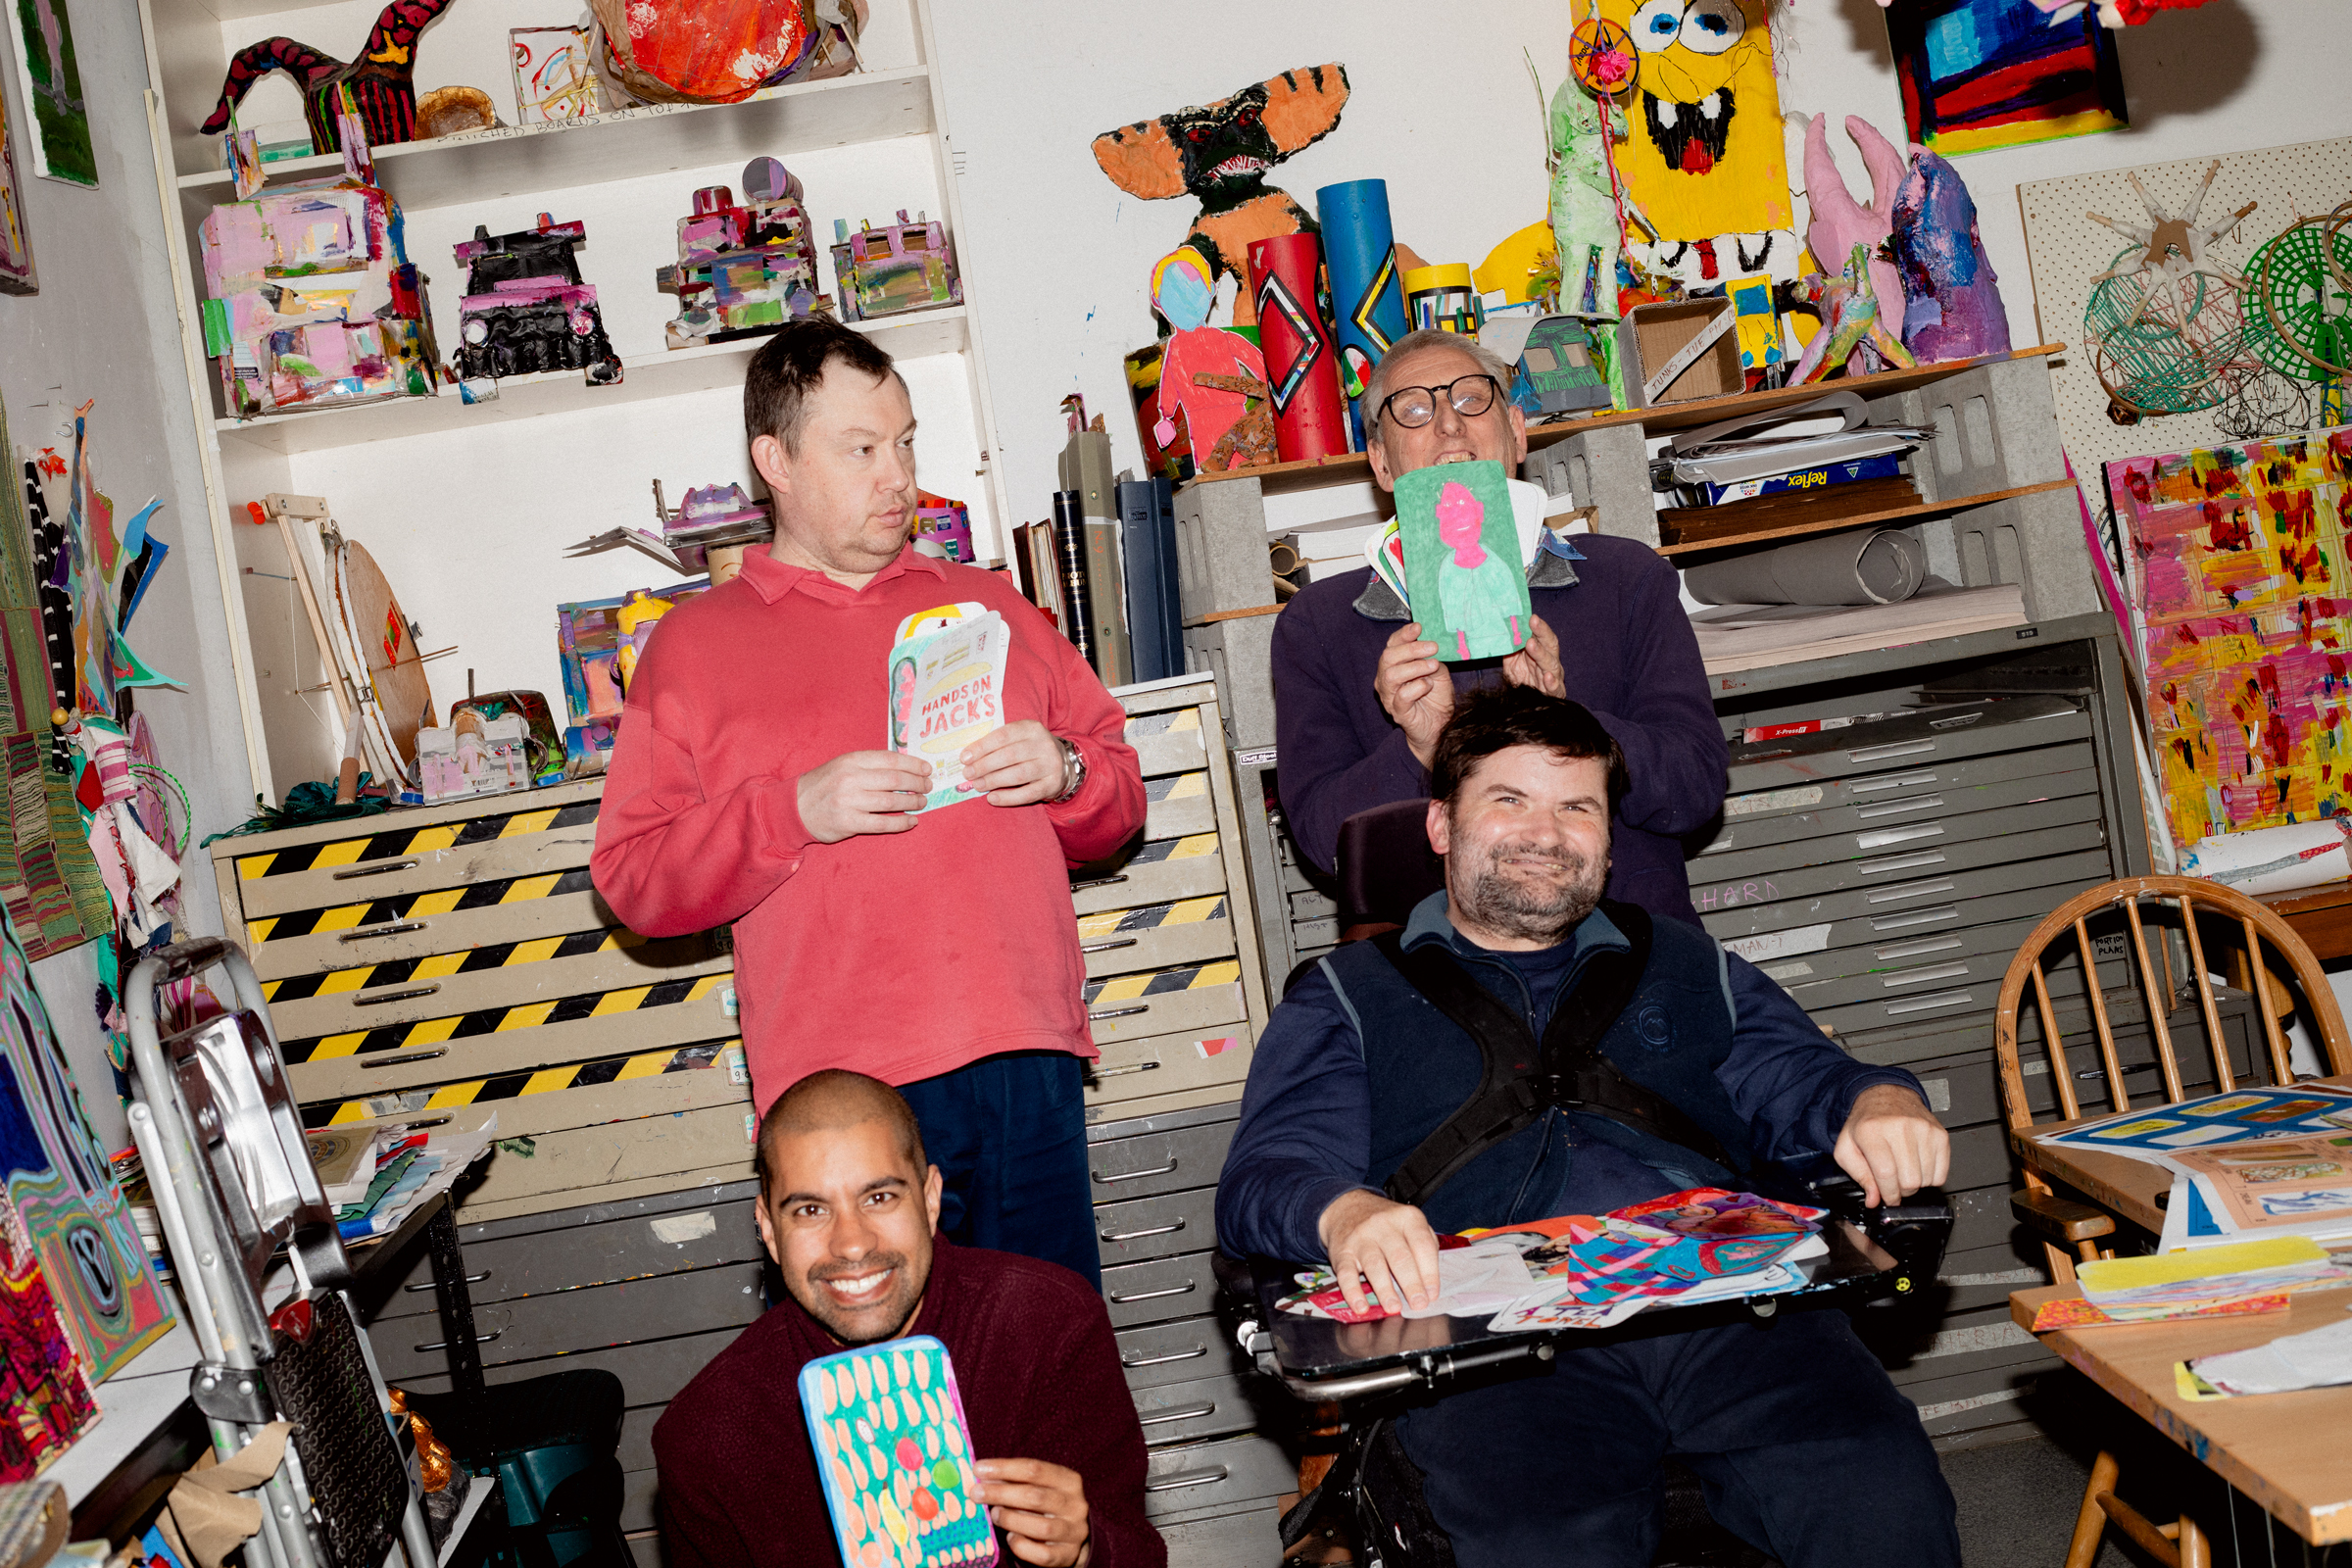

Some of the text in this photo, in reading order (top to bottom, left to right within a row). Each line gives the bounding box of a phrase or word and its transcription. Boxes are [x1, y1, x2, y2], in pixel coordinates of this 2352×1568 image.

[536, 114, 601, 133] BOARDS
[610, 109, 635, 121] ON
[1686, 335, 1705, 358] TUE
[1788, 471, 1828, 488] Reflex
[922, 674, 992, 716] HANDS ON
[919, 695, 996, 738] JACK'S
[1691, 880, 1780, 910] HARD
[2098, 946, 2124, 956] PLANS
[1554, 1304, 1613, 1316] TEA
[1924, 1321, 2031, 1352] ATERIA
